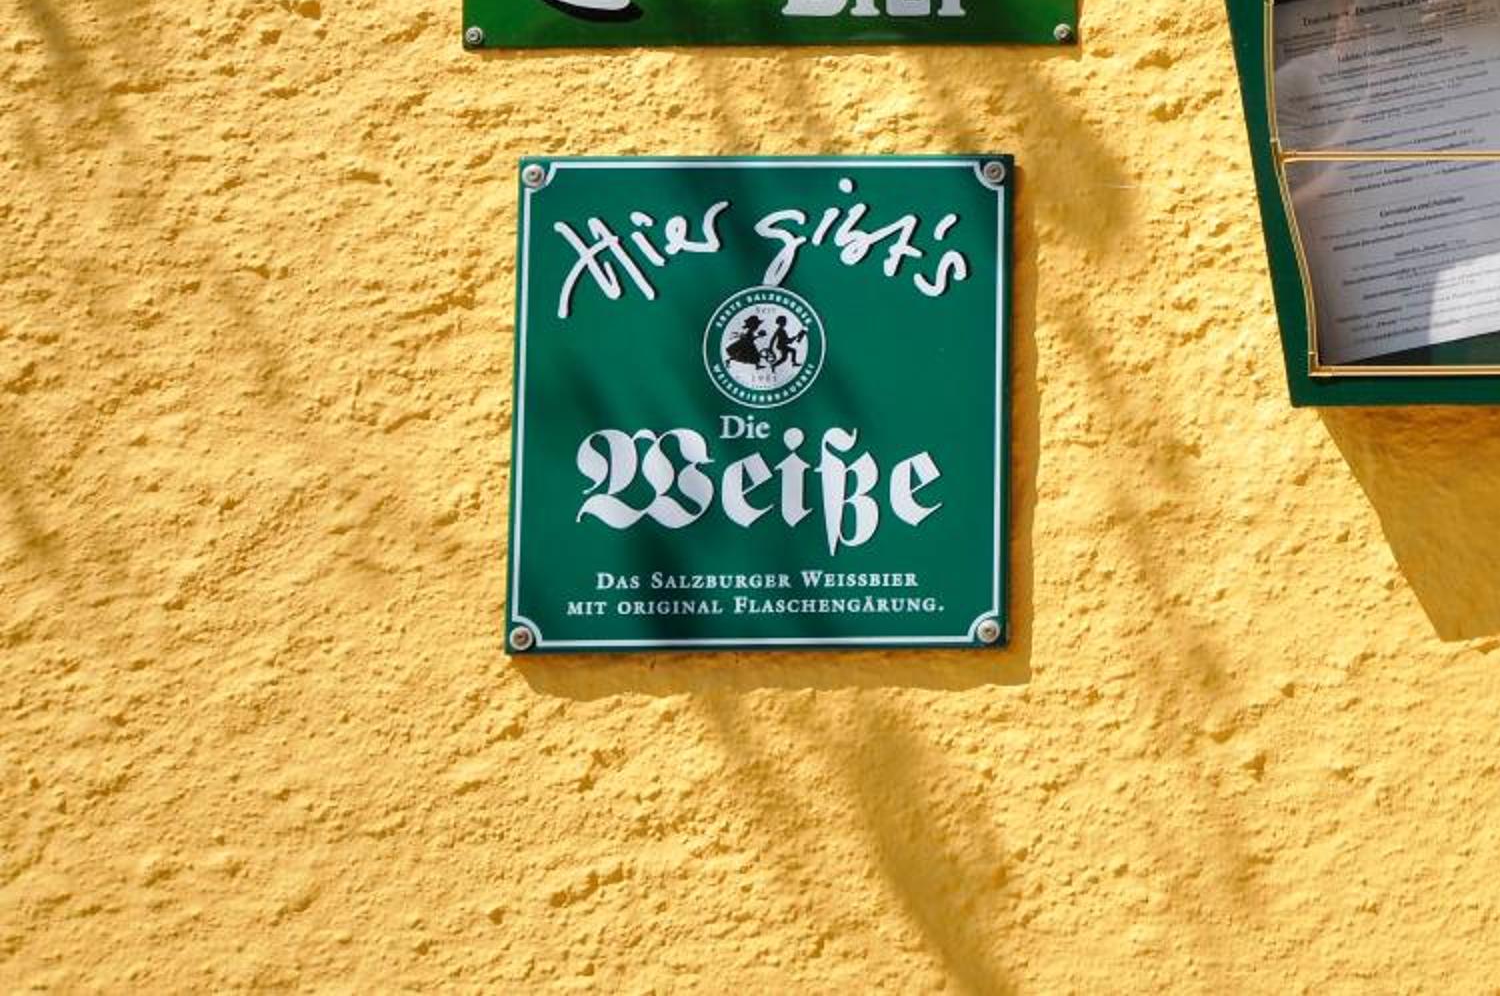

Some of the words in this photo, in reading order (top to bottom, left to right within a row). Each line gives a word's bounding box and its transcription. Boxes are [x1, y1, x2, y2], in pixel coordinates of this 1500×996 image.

[554, 200, 730, 319] Hier
[719, 414, 771, 441] Die
[575, 427, 944, 557] Weiße
